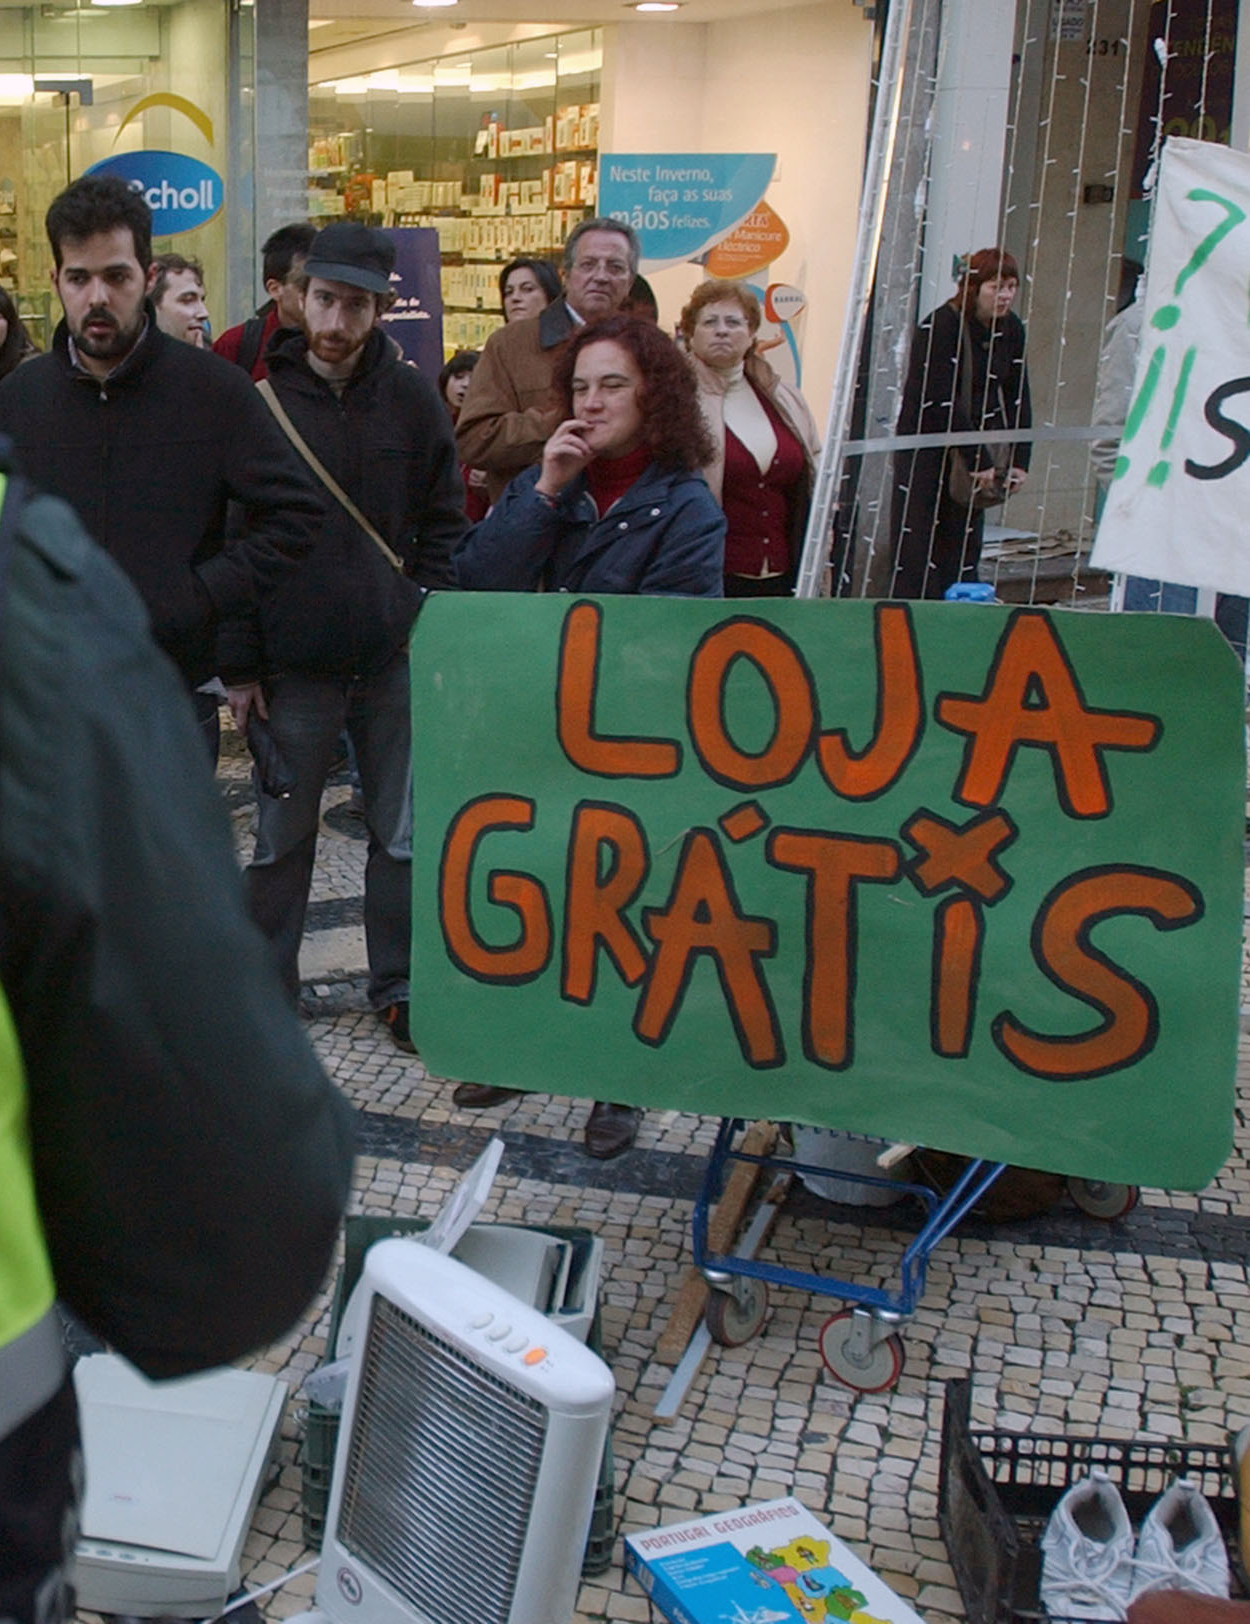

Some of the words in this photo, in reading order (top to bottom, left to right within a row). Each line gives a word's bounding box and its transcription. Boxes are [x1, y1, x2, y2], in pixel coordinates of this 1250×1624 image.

[609, 165, 651, 183] Neste
[656, 165, 715, 184] Inverno,
[648, 185, 678, 206] faça
[682, 188, 699, 202] as
[702, 188, 733, 202] suas
[556, 600, 1164, 819] LOJA
[639, 1525, 712, 1551] PORTUGAL
